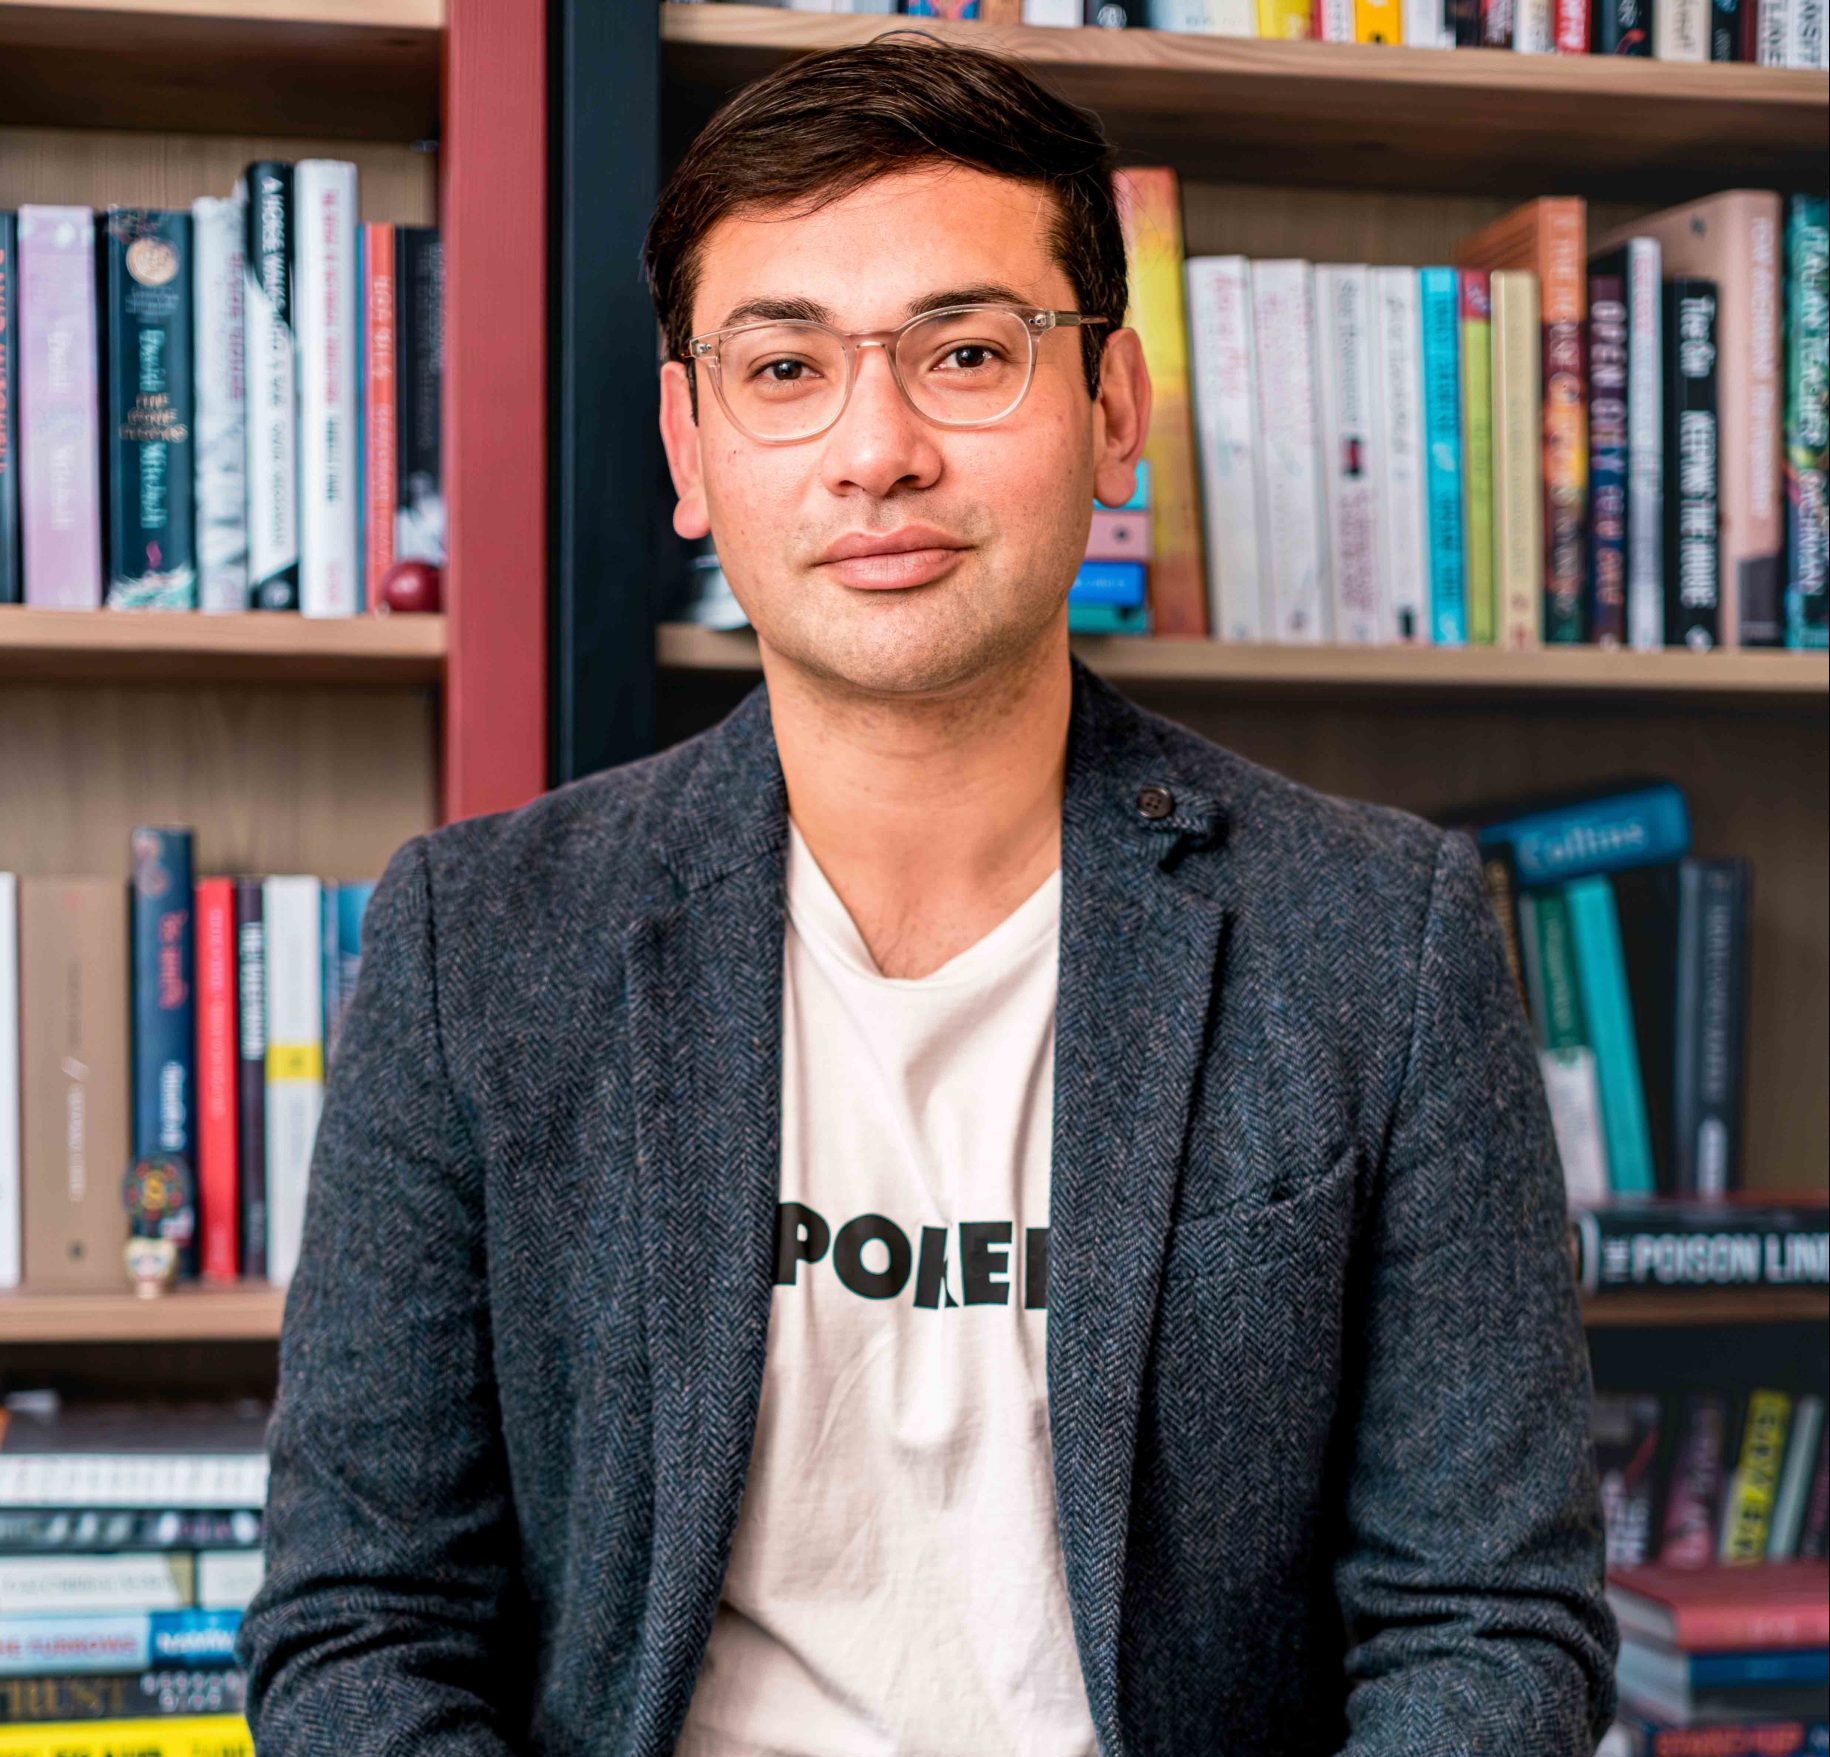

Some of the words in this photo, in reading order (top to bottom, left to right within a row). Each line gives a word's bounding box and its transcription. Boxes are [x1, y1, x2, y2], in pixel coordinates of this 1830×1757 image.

[1591, 300, 1625, 387] OPEN
[1591, 398, 1625, 473] CITY
[1631, 1232, 1761, 1284] POISON
